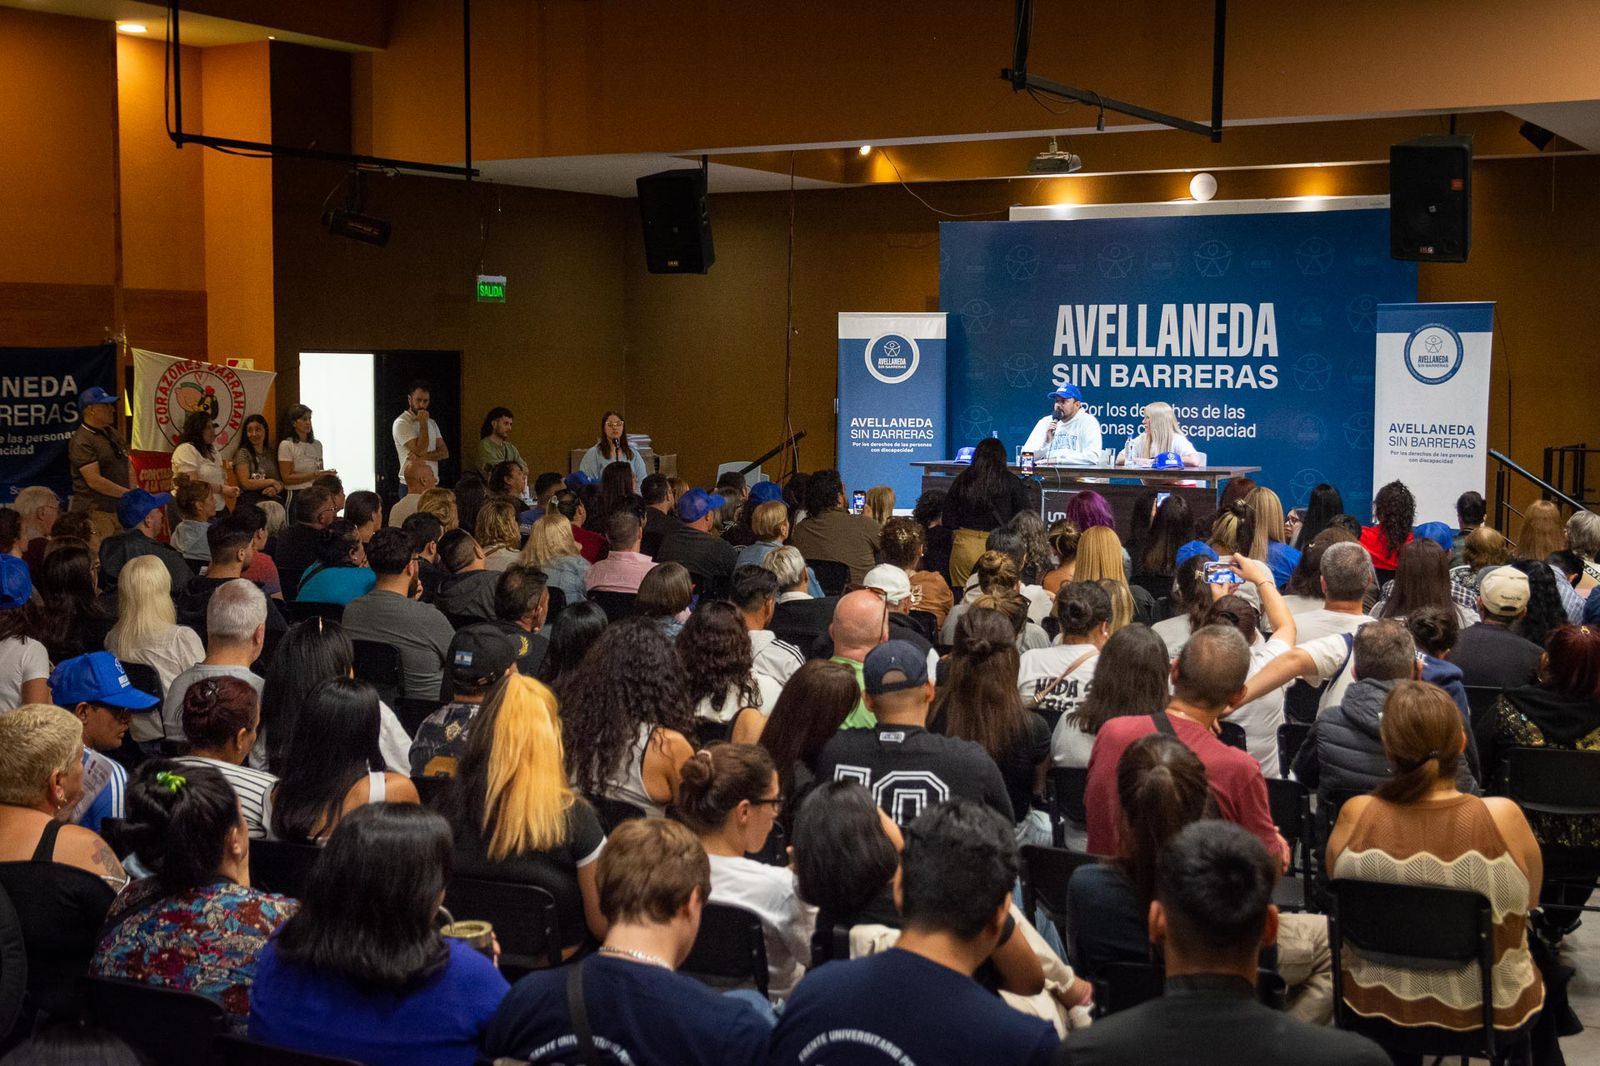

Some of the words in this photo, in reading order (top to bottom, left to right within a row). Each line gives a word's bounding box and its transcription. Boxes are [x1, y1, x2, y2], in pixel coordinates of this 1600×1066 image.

[480, 284, 503, 298] SALIDA
[1053, 303, 1279, 357] AVELLANEDA
[1418, 355, 1449, 363] AVELLANEDA
[1052, 363, 1100, 387] SIN
[1110, 364, 1279, 389] BARRERAS
[1106, 402, 1127, 417] los
[1129, 402, 1199, 419] dehos
[1201, 404, 1220, 419] de
[1224, 404, 1245, 419] las
[850, 417, 933, 428] AVELLANEDA
[850, 429, 869, 439] SIN
[873, 429, 934, 440] BARRERAS
[1389, 423, 1475, 436] AVELLANEDA
[8, 433, 24, 444] las
[1389, 435, 1408, 447] SIN
[1411, 436, 1476, 449] BARRERAS
[0, 444, 34, 456] cidad
[829, 1028, 903, 1060] UNIVERSITARIO
